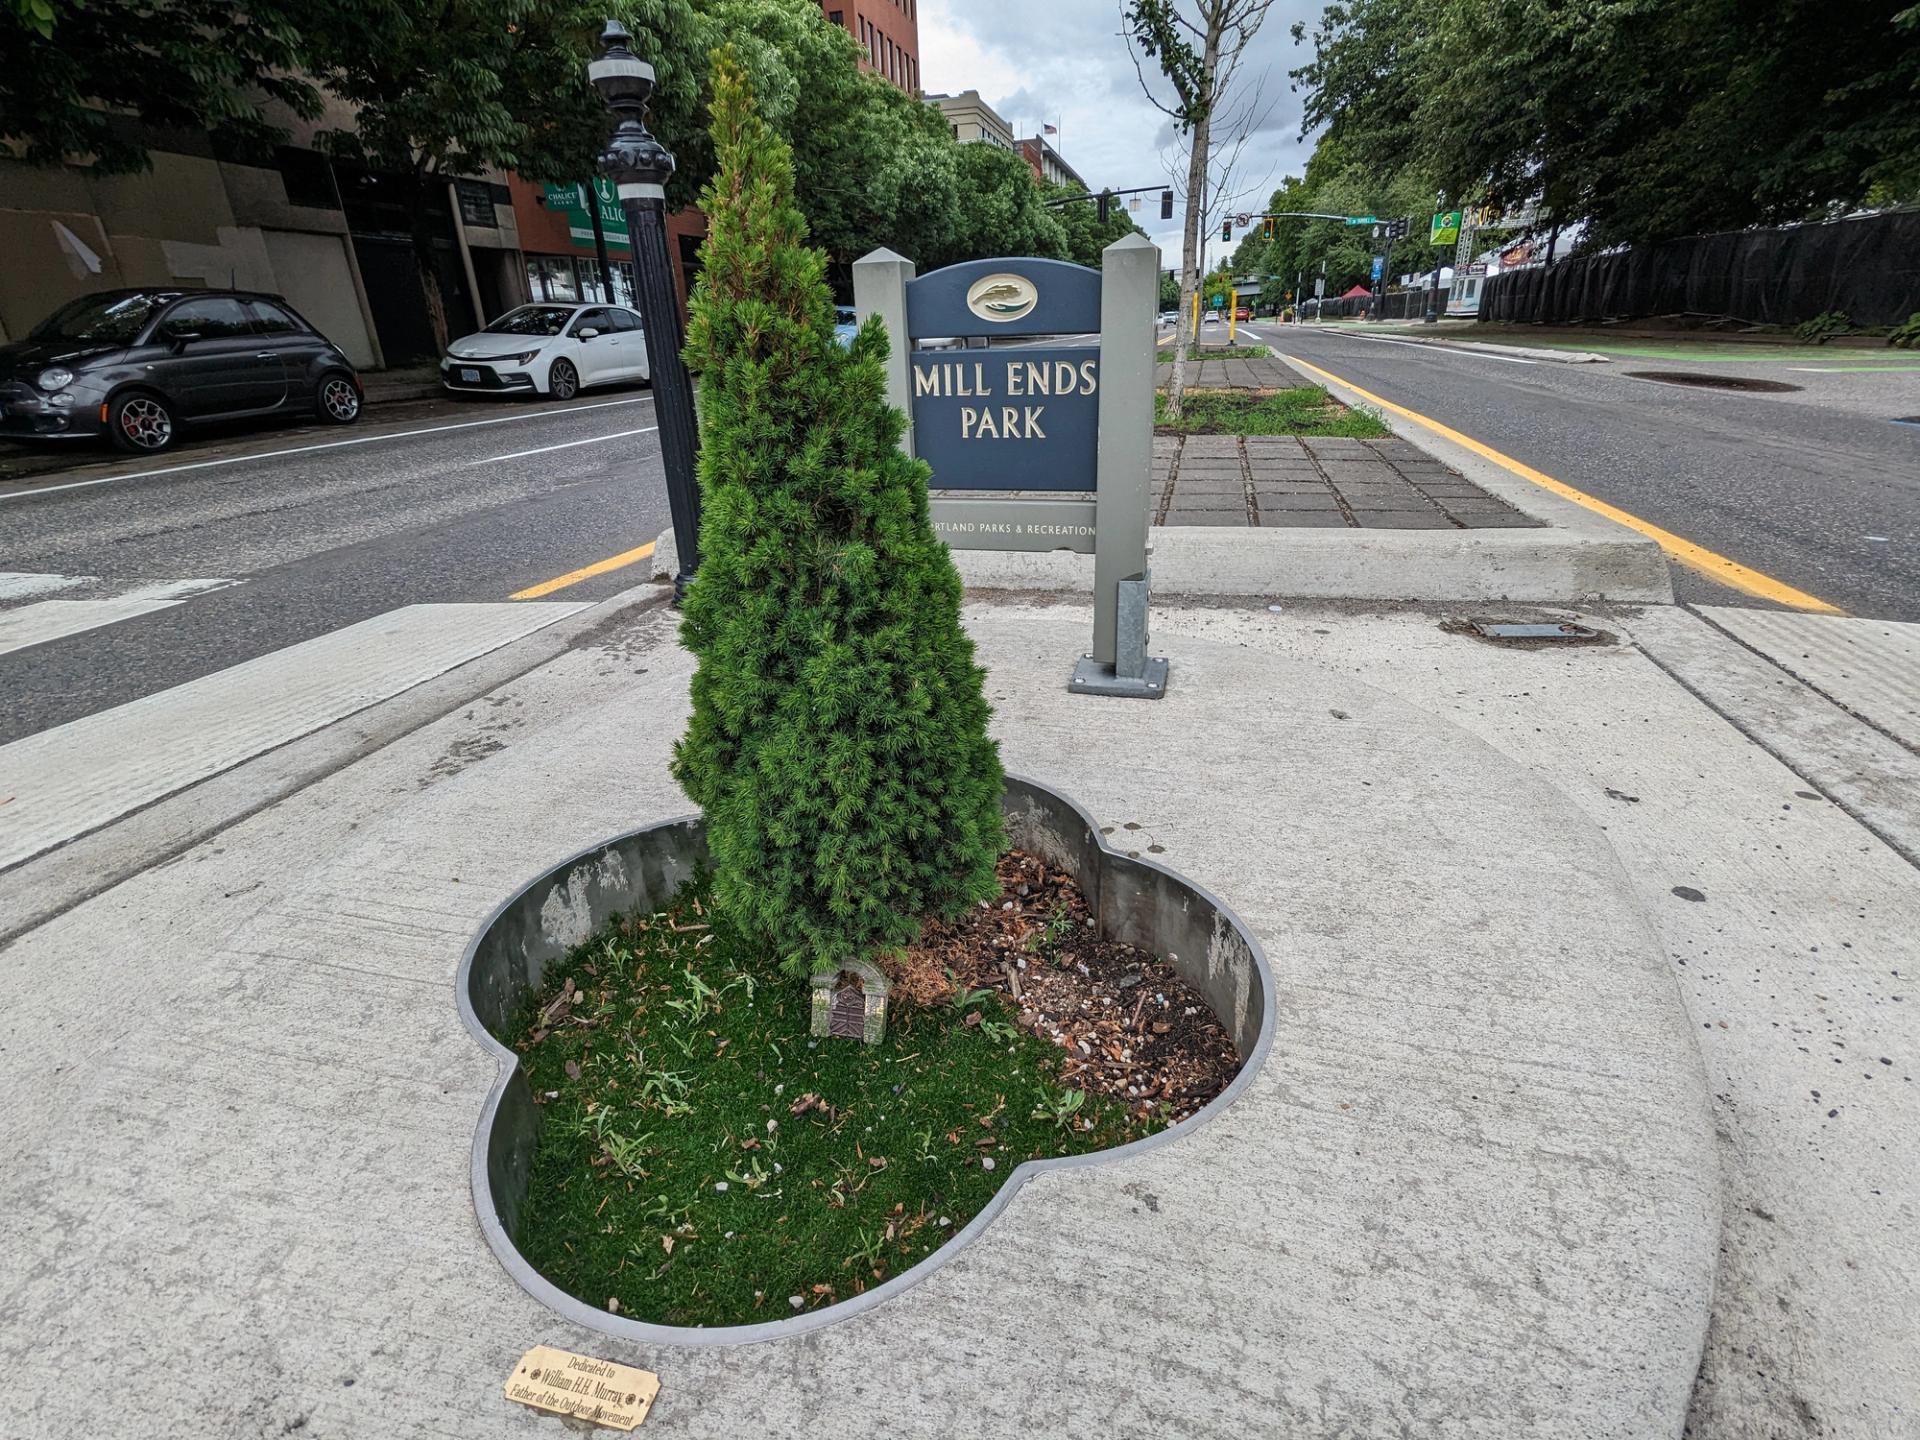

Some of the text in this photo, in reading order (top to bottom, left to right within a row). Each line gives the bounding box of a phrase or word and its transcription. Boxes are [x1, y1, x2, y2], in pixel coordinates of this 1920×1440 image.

[548, 191, 577, 200] CHALICE
[913, 360, 1097, 397] MILL ENDS
[961, 406, 1046, 439] PARK
[931, 522, 1096, 536] RTLAND PARKS & RECREATION
[567, 1356, 616, 1379] Dedicated to
[541, 1368, 625, 1407] William H.H. Murray
[510, 1383, 633, 1427] Father of the Outdoor Movement
